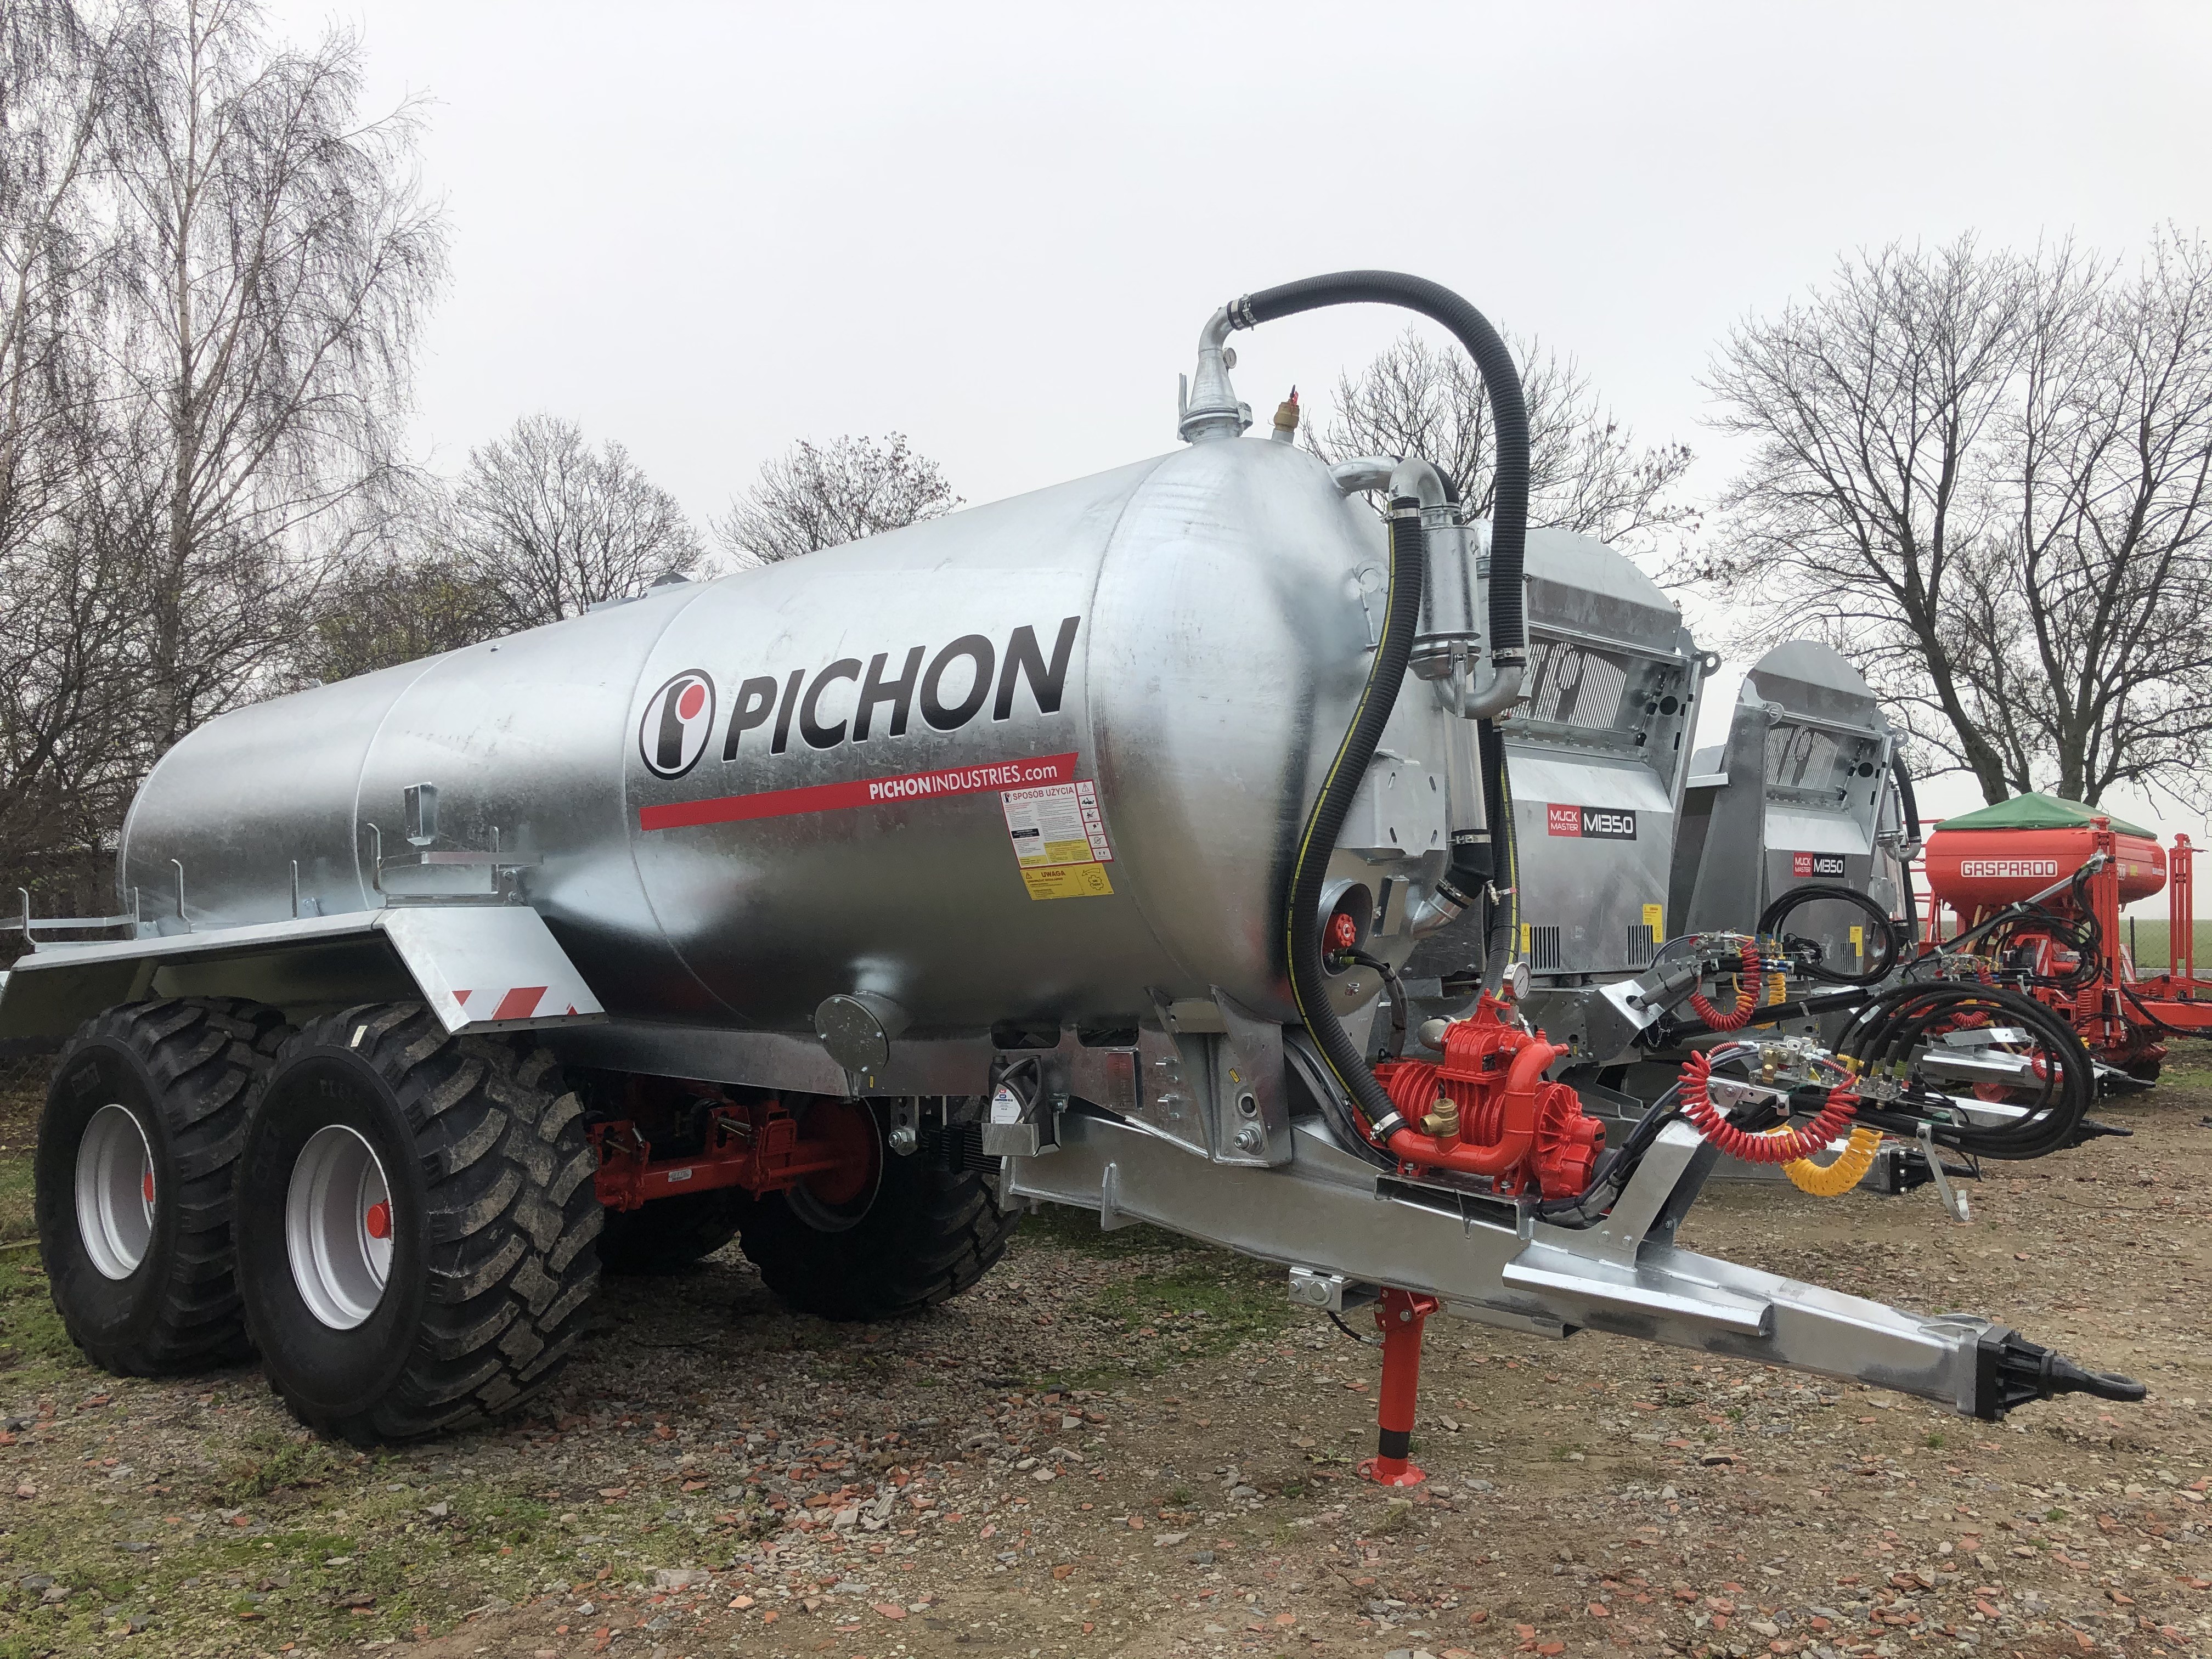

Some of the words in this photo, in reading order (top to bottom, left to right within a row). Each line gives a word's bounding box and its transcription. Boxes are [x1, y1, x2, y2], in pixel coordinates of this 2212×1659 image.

[721, 616, 1081, 763] PICHON
[869, 765, 1058, 800] PICHONINDUSTRIES.com
[1013, 789, 1044, 800] SPOSÓB
[1046, 786, 1074, 797] UŻYCIA
[1550, 810, 1578, 822] MUCK
[1550, 822, 1578, 831] MASTER
[1795, 857, 1811, 866] MUCK
[1962, 862, 2056, 876] GASPARDO
